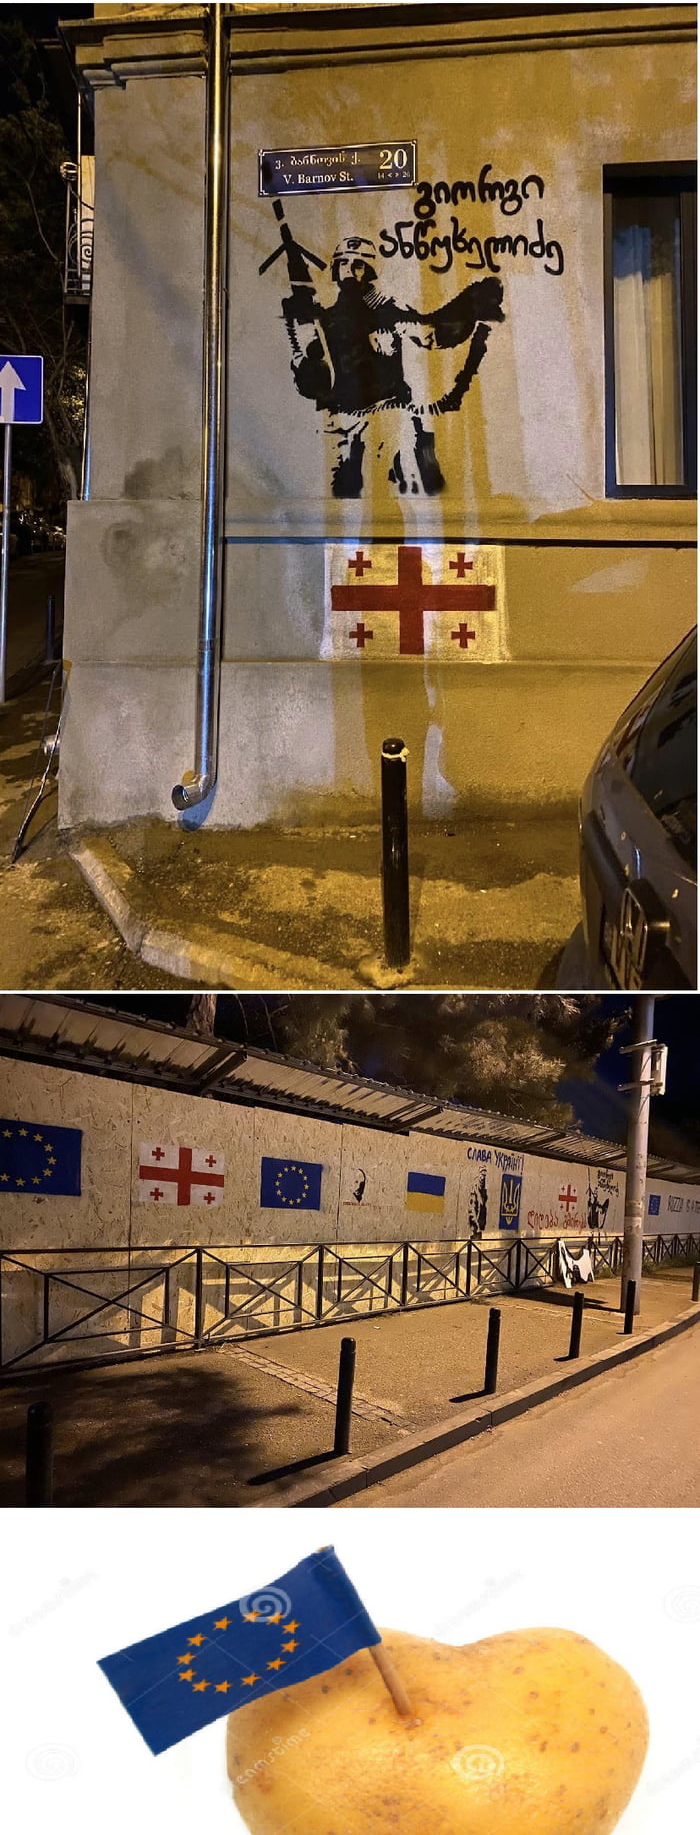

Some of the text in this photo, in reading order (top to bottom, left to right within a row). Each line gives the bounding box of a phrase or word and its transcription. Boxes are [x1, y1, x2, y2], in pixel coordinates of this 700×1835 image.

[290, 151, 346, 167] ბარნოვის
[379, 149, 408, 170] 20
[283, 171, 354, 184] V. Barnov St.
[413, 164, 545, 219] გიორგი
[379, 216, 564, 275] ანწუხელიძე
[467, 1146, 492, 1163] СЛАВА
